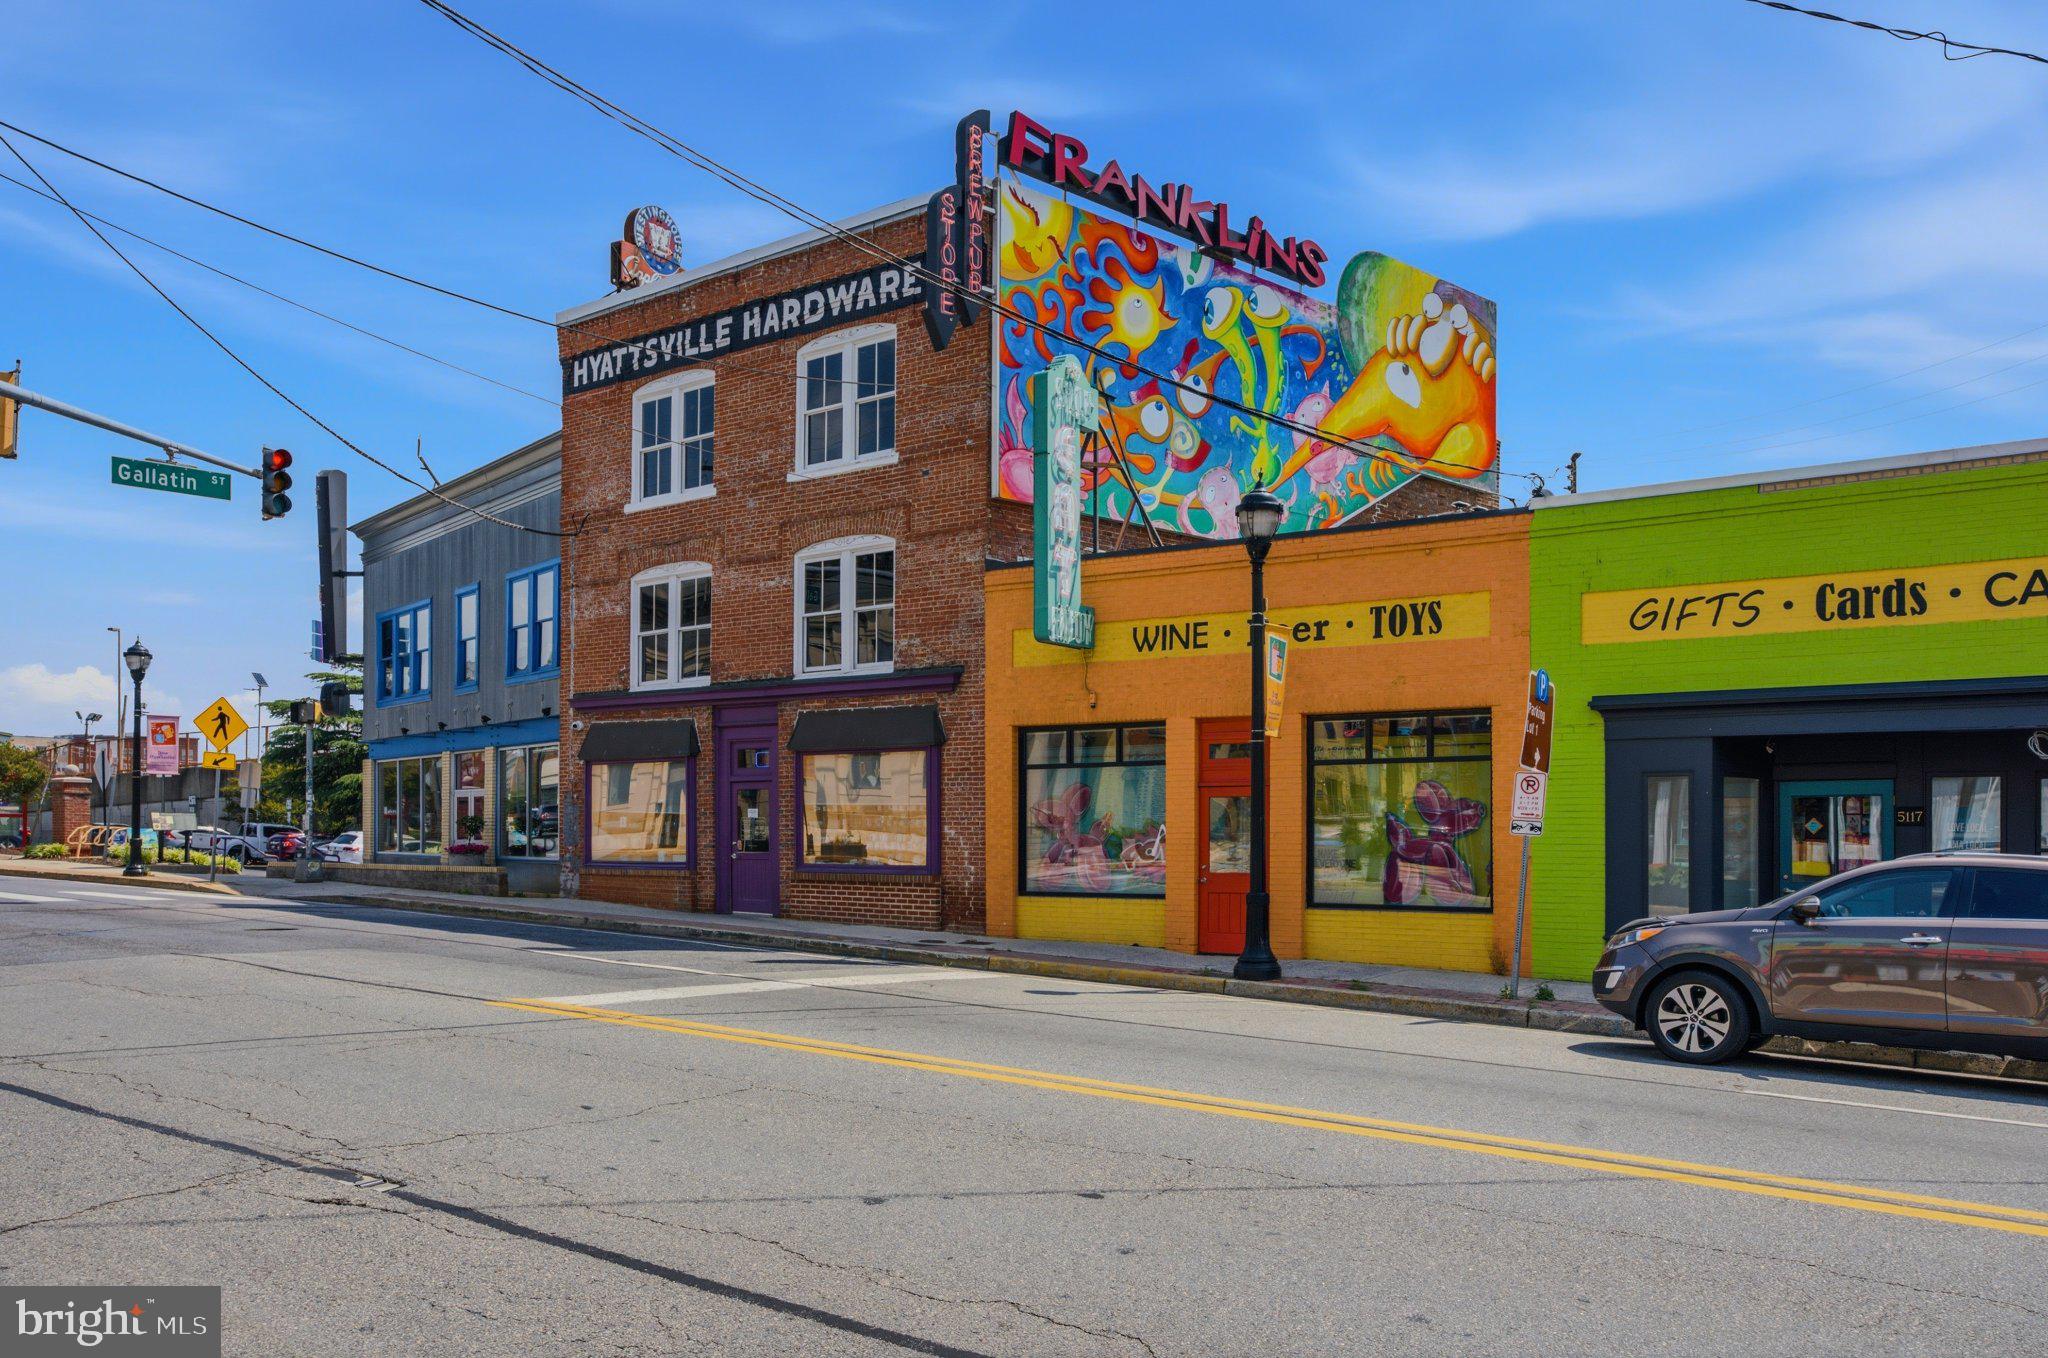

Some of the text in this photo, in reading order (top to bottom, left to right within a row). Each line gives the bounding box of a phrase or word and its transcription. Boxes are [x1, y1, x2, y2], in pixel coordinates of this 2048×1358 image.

[635, 206, 683, 264] WESTINGHOUSE
[941, 193, 956, 315] STORE
[573, 316, 733, 388] HYATTSVILLE
[743, 261, 922, 340] HARDWARE
[118, 463, 226, 491] Gallatin ST
[1132, 622, 1209, 653] WINE
[1370, 600, 1442, 640] TOYS
[1629, 589, 1765, 632] GIFTS
[1815, 578, 1928, 622] Cards
[1526, 720, 1535, 735] Lot
[1528, 702, 1546, 725] Parking
[1897, 811, 1923, 823] 5117
